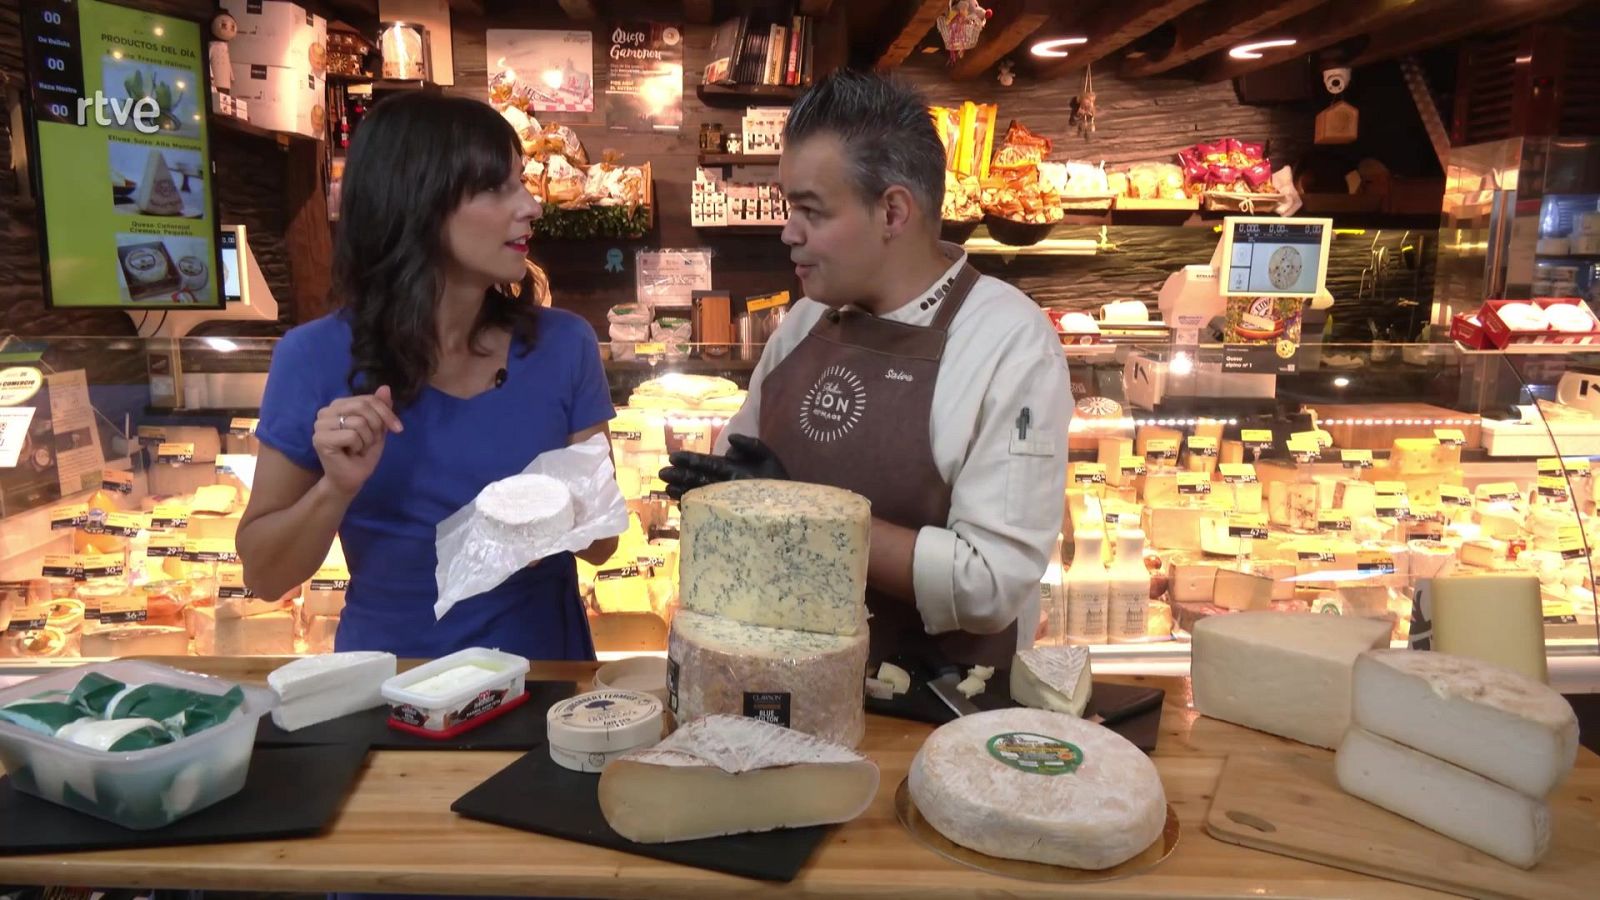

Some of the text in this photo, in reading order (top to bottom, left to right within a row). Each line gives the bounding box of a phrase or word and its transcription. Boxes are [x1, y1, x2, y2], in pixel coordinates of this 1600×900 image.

[44, 11, 61, 25] 00
[612, 27, 645, 46] Queso
[101, 33, 196, 58] PRODUCTOS DEL DÍA
[48, 57, 64, 71] 00
[52, 104, 69, 117] 00
